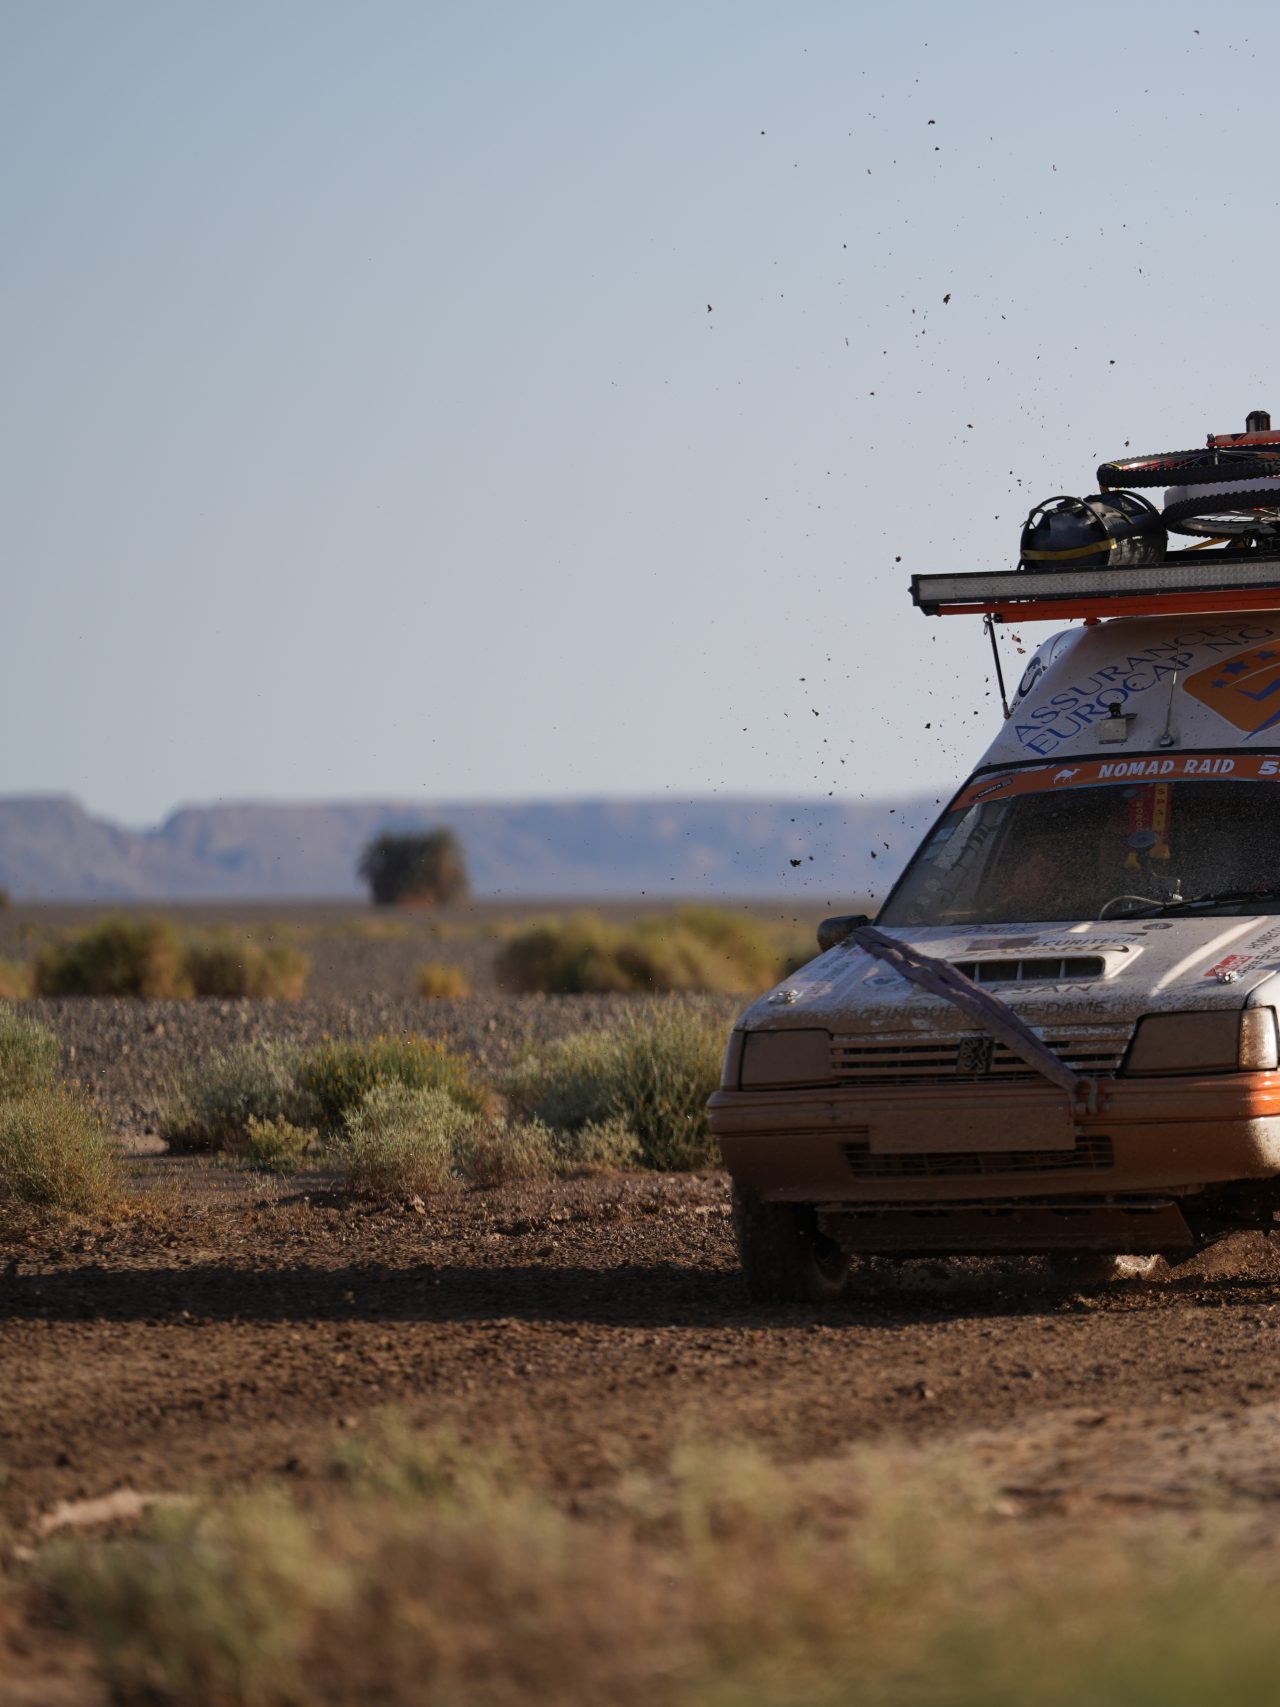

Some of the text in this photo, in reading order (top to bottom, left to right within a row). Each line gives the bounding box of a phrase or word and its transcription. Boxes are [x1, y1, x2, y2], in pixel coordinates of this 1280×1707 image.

[1024, 652, 1193, 755] EUROCAP
[1097, 760, 1175, 778] NOMAD
[1183, 759, 1235, 774] RAID
